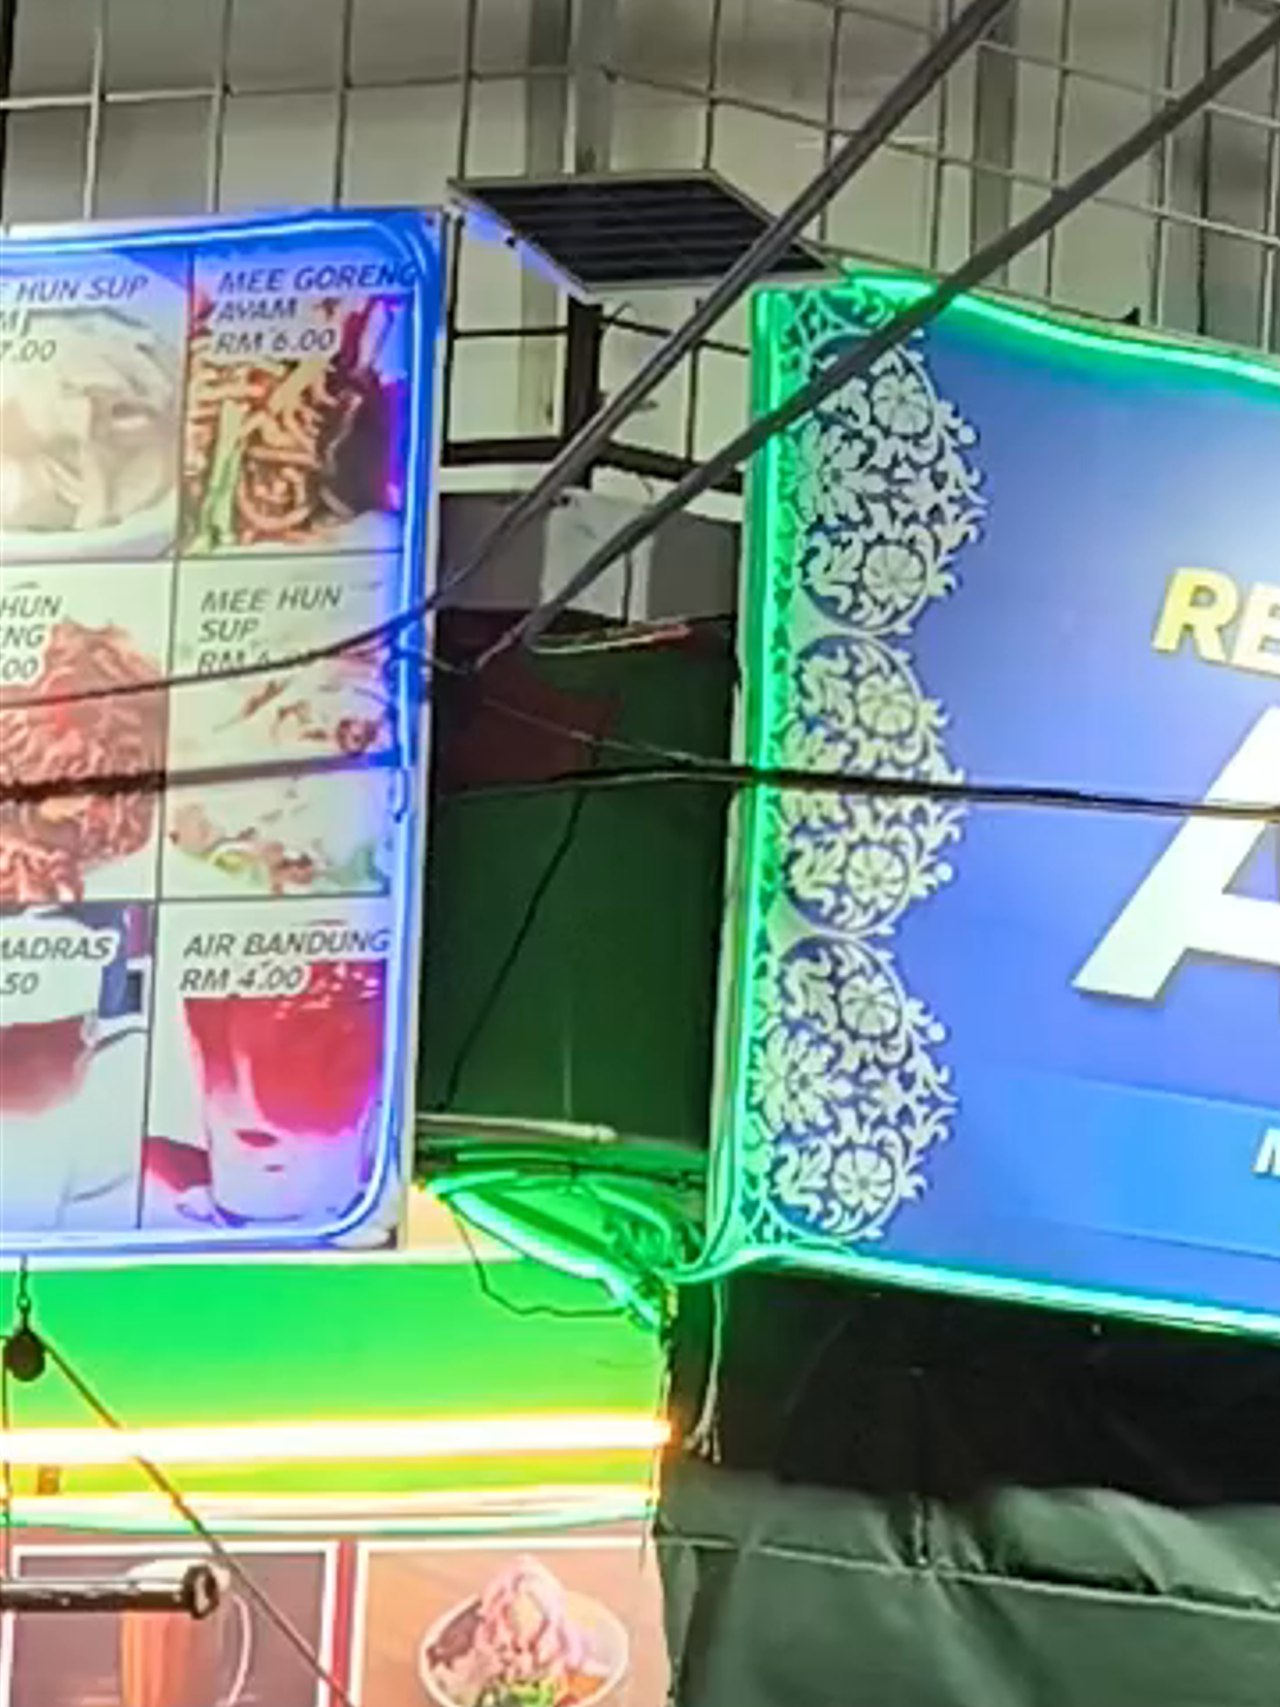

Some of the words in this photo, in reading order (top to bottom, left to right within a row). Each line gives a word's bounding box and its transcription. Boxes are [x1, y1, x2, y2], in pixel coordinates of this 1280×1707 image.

[16, 278, 79, 302] HUN
[84, 274, 150, 299] SUP
[218, 269, 285, 293] MEE
[292, 261, 418, 290] GORENG
[214, 330, 265, 353] RM
[271, 327, 336, 352] 6.00
[201, 590, 267, 612] MEE
[276, 585, 344, 610] HUN
[200, 619, 259, 642] SUP
[183, 932, 237, 959] AIR
[243, 928, 390, 957] BANDUNG
[180, 967, 230, 991] RM
[236, 964, 303, 990] 4.00
